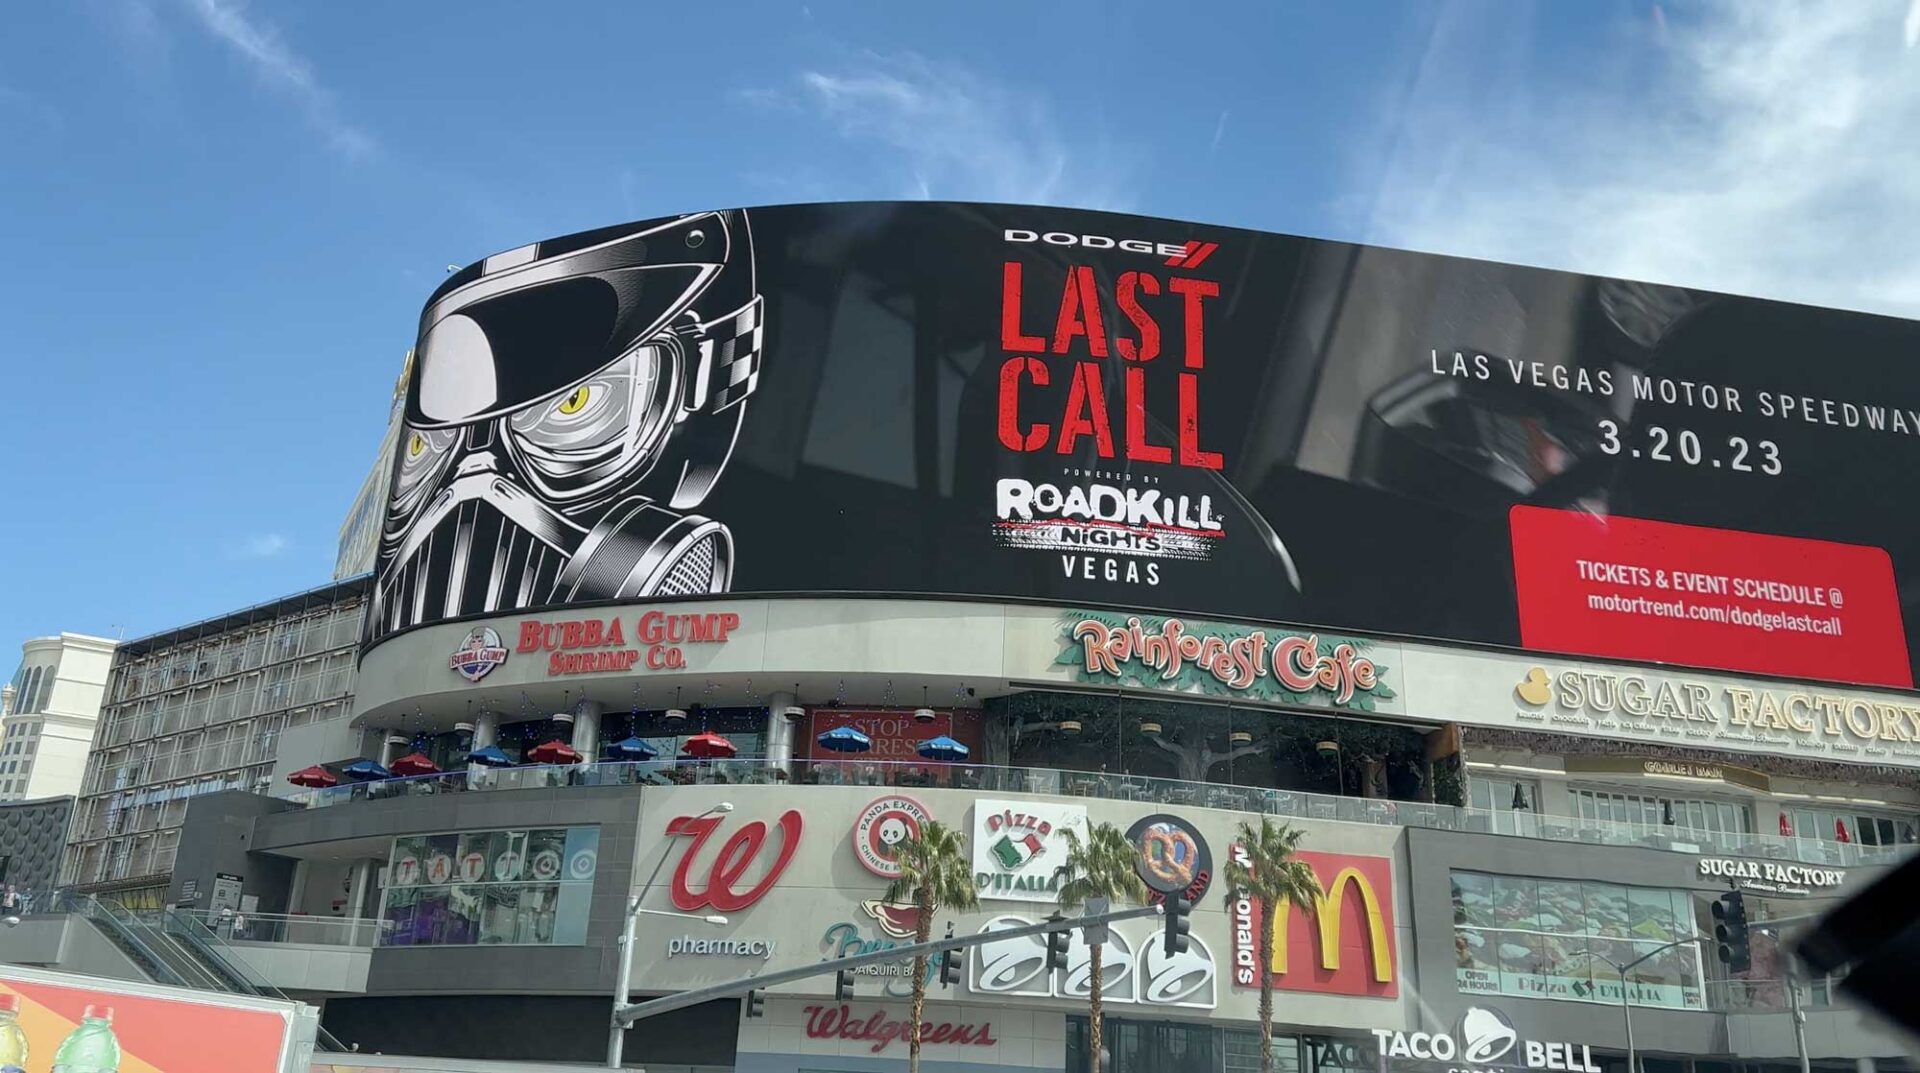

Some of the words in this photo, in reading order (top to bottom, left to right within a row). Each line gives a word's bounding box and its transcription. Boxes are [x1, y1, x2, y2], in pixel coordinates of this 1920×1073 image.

[1004, 229, 1188, 258] DODGE
[1002, 262, 1219, 369] LAST
[1431, 350, 1490, 381] LAS
[1508, 360, 1614, 396] VEGAS
[1632, 375, 1743, 413] MOTOR
[1760, 392, 1920, 436] SPEEDWAY
[997, 356, 1223, 470] CALL
[1599, 420, 1783, 476] 3.20.23
[1064, 468, 1131, 482] POWERED
[1144, 476, 1160, 484] BY
[996, 478, 1222, 530] ROADKILL
[1062, 555, 1160, 586] VEGAS
[1576, 560, 1651, 587] TICKETS
[1655, 570, 1669, 590] &
[1673, 572, 1729, 595] EVENT
[1733, 578, 1827, 607] SCHEDULE
[1829, 588, 1844, 609] @
[1588, 594, 1842, 636] motortrend.com/dodgelastcall
[516, 616, 625, 653] BUBBA
[638, 611, 740, 644] GUMP
[450, 652, 479, 668] BUBBA
[479, 648, 506, 664] GUMP
[549, 649, 640, 675] SHRIMP
[1073, 616, 1267, 690] Rainforest
[1272, 633, 1379, 705] Cafe
[1558, 670, 1718, 723] SUGAR
[1727, 686, 1920, 743] FACTORY
[855, 719, 910, 737] STOP
[860, 803, 890, 831] PANDA
[893, 801, 927, 827] EXPRE
[988, 809, 1052, 836] Pizza
[861, 844, 890, 871] CHINESE
[1700, 858, 1761, 879] SUGAR
[1763, 863, 1846, 886] FACTORY
[976, 872, 1058, 892] D'ITALIA
[668, 934, 776, 960] pharmacy
[1457, 979, 1468, 989] 24
[1469, 981, 1498, 991] HOURS
[1464, 970, 1489, 981] OPEN
[1518, 977, 1567, 993] Pizza
[803, 1004, 997, 1052] Walgreens
[1371, 1029, 1455, 1061] TACO
[1525, 1040, 1602, 1073] BELL
